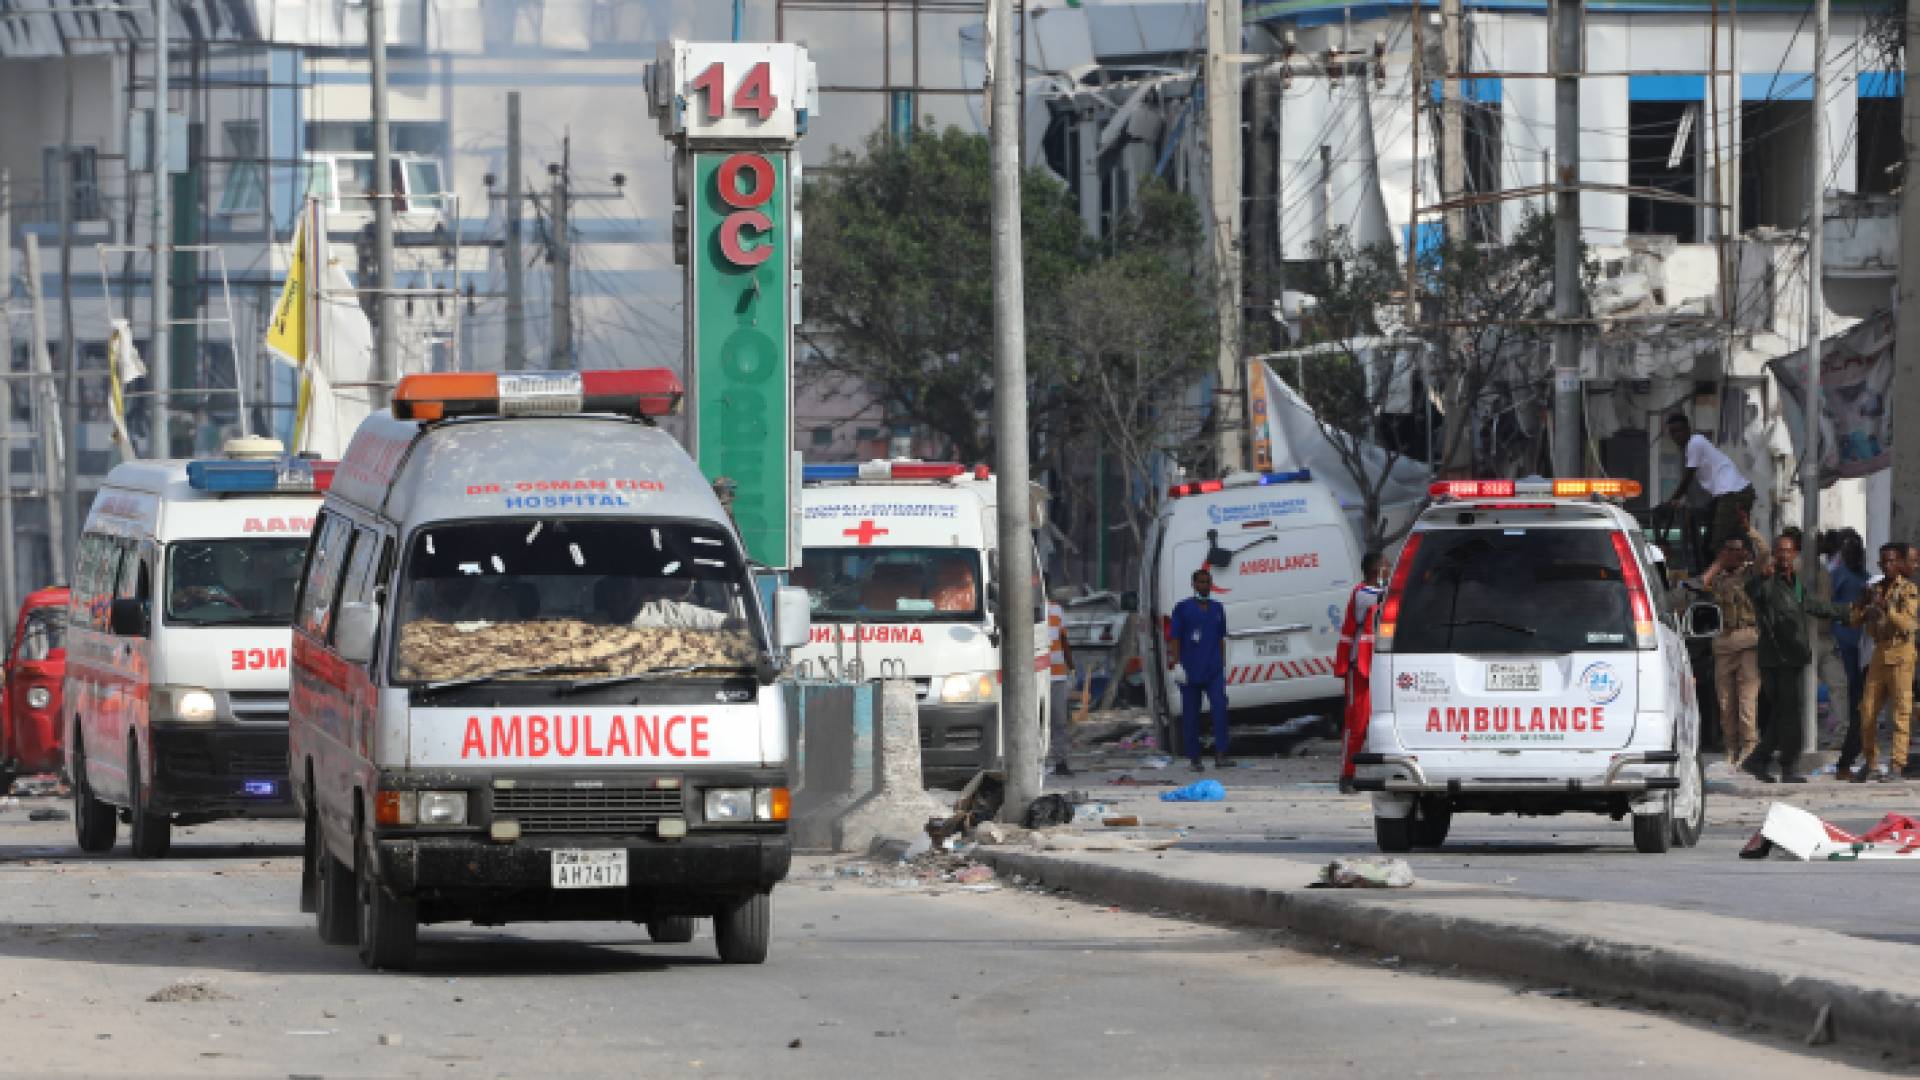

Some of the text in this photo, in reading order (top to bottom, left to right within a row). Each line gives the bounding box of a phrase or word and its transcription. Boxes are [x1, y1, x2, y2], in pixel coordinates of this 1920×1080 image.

[693, 62, 778, 120] 14
[514, 480, 606, 491] OSMAN
[506, 494, 629, 508] HOSPITAL
[1239, 553, 1319, 575] AMBULANCE
[1425, 706, 1605, 732] AMBULANCE
[461, 715, 711, 758] AMBULANCE
